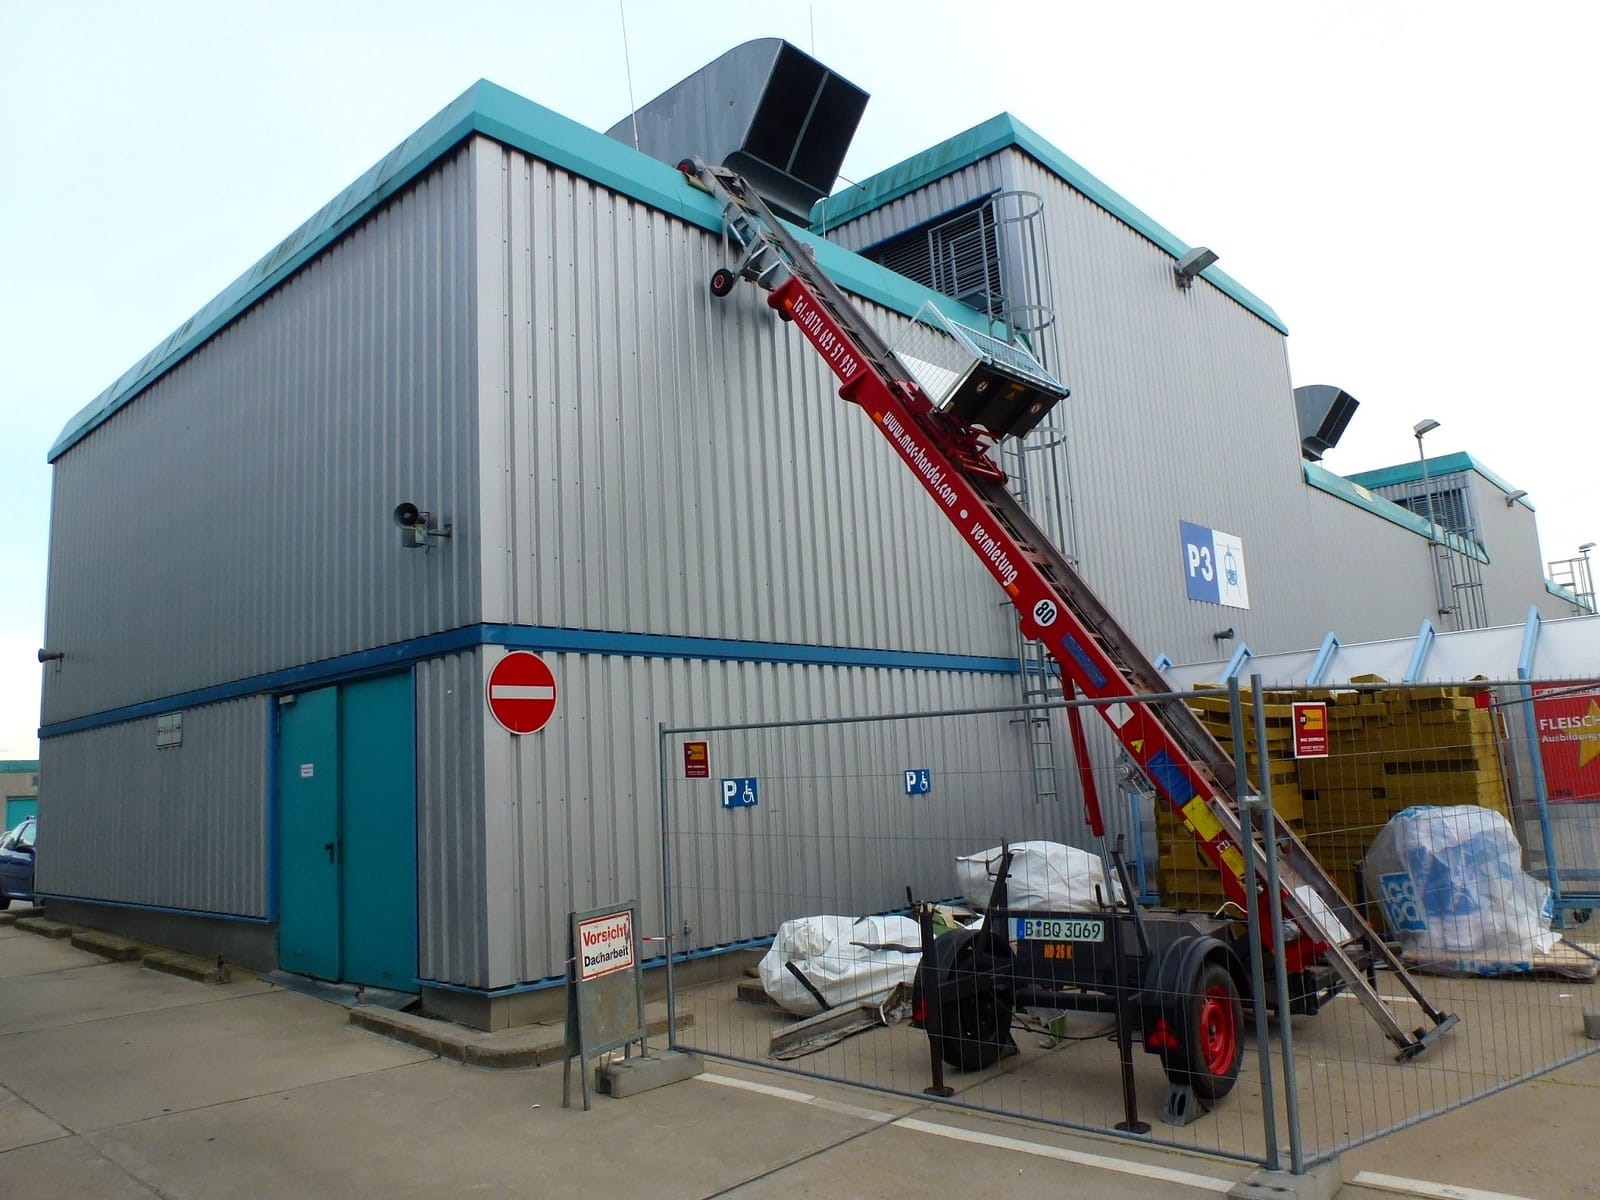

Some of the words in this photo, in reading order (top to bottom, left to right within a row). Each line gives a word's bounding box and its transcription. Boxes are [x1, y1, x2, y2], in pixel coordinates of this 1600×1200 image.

[819, 329, 836, 351] 625
[830, 343, 845, 361] 57
[839, 354, 858, 378] 930
[970, 522, 1018, 586] vermietung
[1187, 543, 1213, 582] P3
[1035, 601, 1056, 624] 80
[724, 781, 737, 805] P
[906, 771, 917, 792] P
[583, 923, 627, 946] Vorsicht
[1026, 921, 1034, 936] B
[1043, 922, 1061, 937] BQ
[1065, 922, 1101, 938] 3069
[584, 945, 629, 968] Dacharbeit
